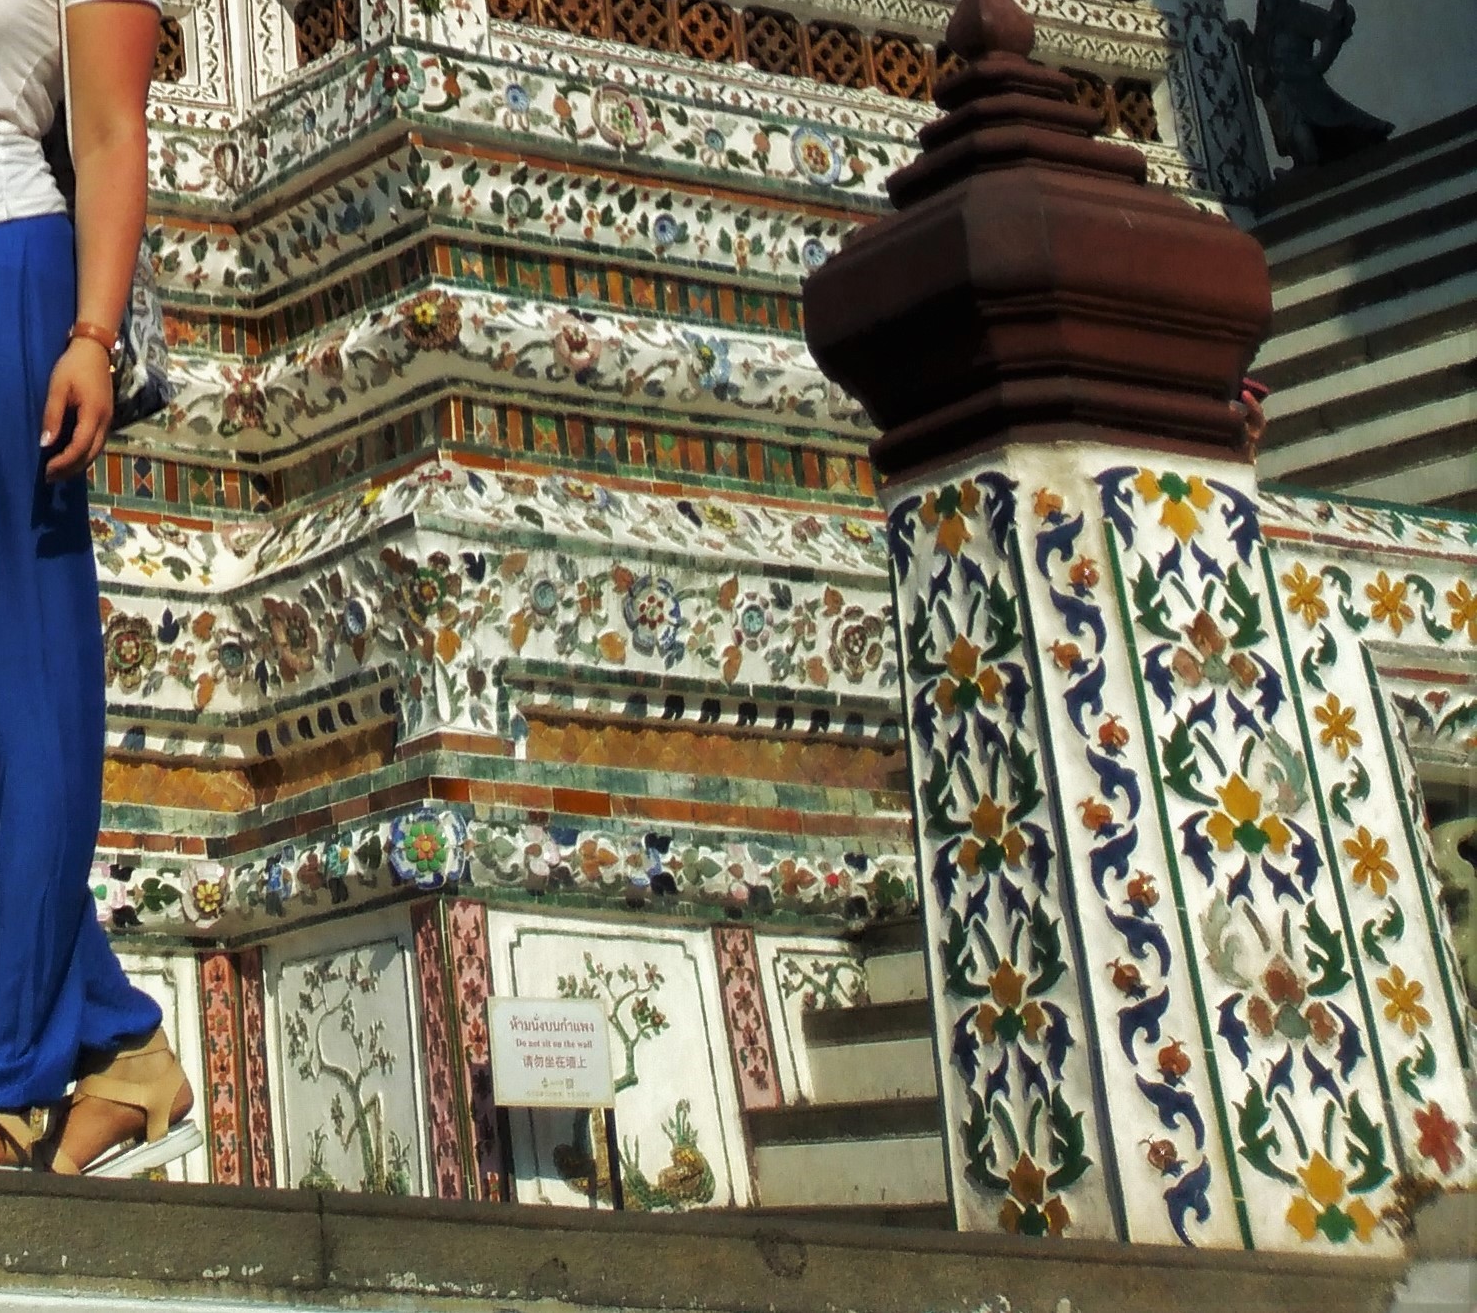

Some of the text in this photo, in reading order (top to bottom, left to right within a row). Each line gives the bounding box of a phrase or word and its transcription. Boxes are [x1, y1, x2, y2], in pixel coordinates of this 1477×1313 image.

[516, 1038, 593, 1049] Do not sit on the wall
[523, 1054, 588, 1070] 请勿坐在墙上
